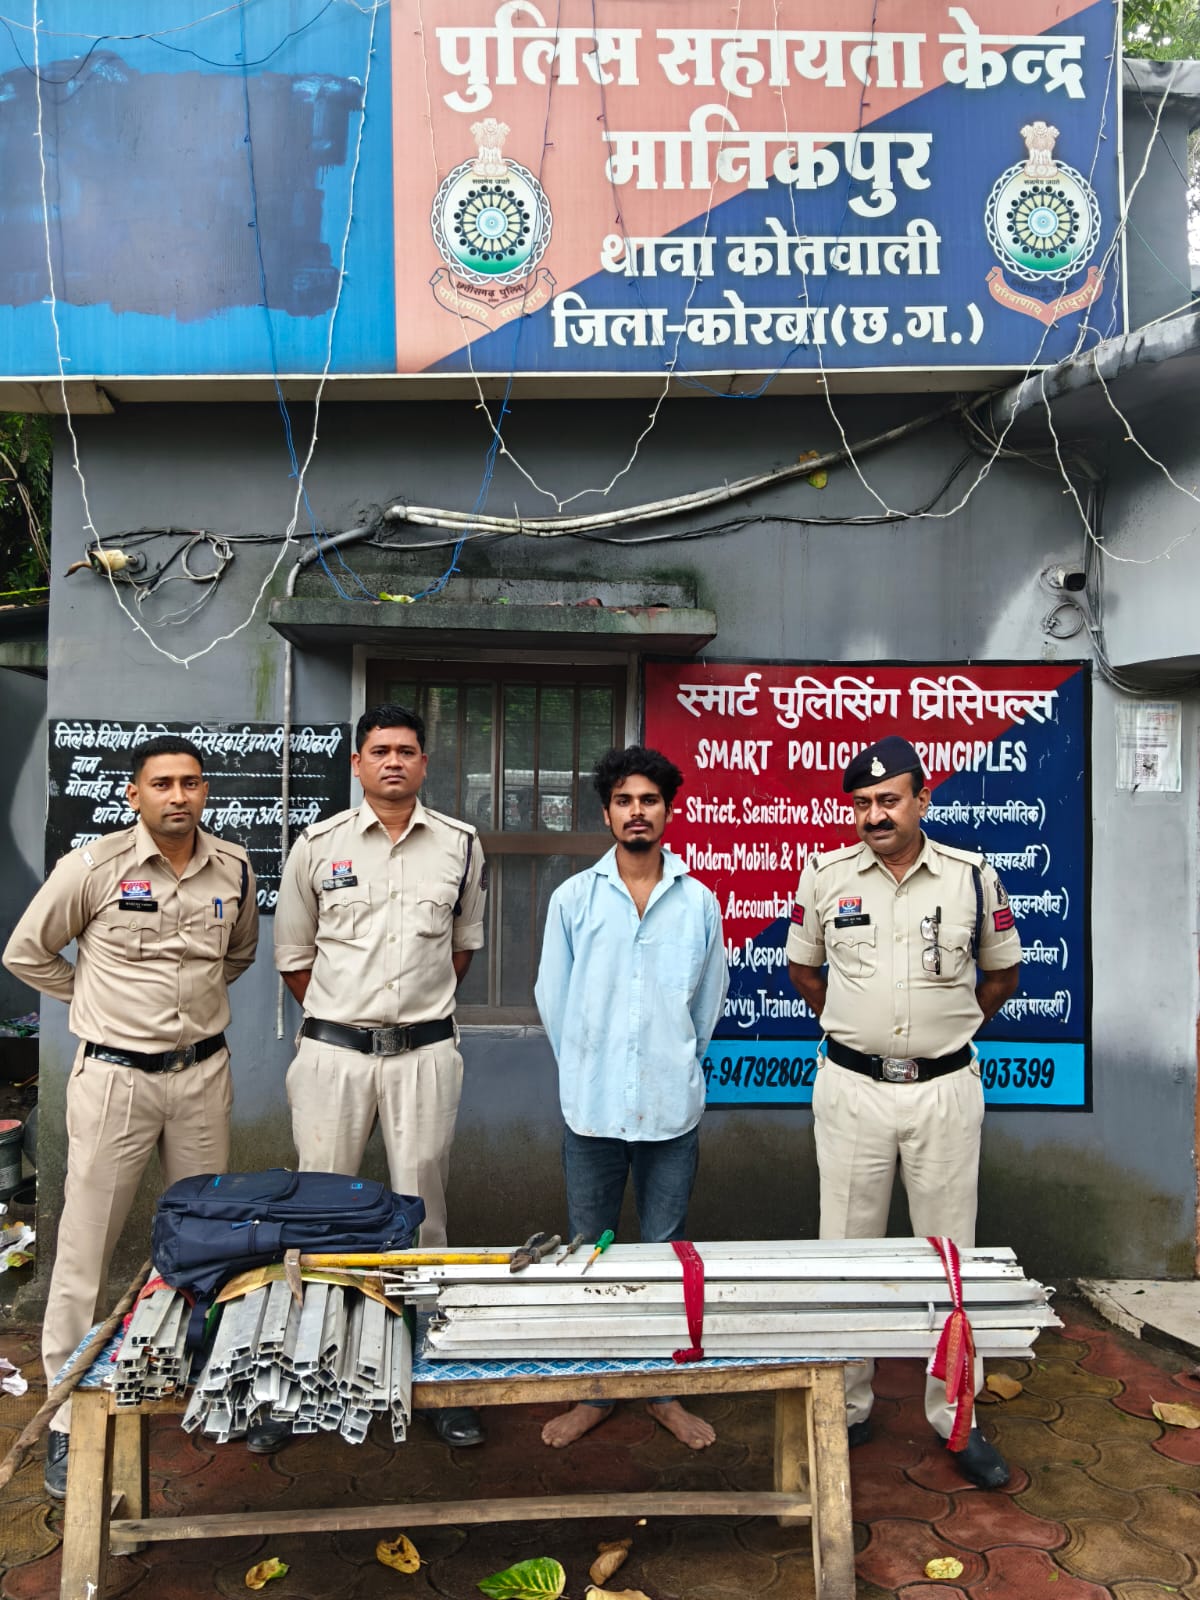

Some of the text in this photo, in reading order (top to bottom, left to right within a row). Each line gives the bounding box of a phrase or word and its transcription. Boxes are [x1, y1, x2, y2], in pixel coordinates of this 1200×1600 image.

[436, 0, 1086, 112] पुलिस सहायता केन्द्र
[602, 103, 934, 218] मानिकपुर
[600, 217, 941, 278] थाना कोतवाली
[677, 673, 762, 718] स्मार्ट
[769, 675, 900, 729] पुलिसिंग
[72, 756, 103, 774] नाम
[695, 739, 773, 776] SMART
[908, 740, 1028, 781] RINCIPLES
[742, 797, 809, 825] Sensitive
